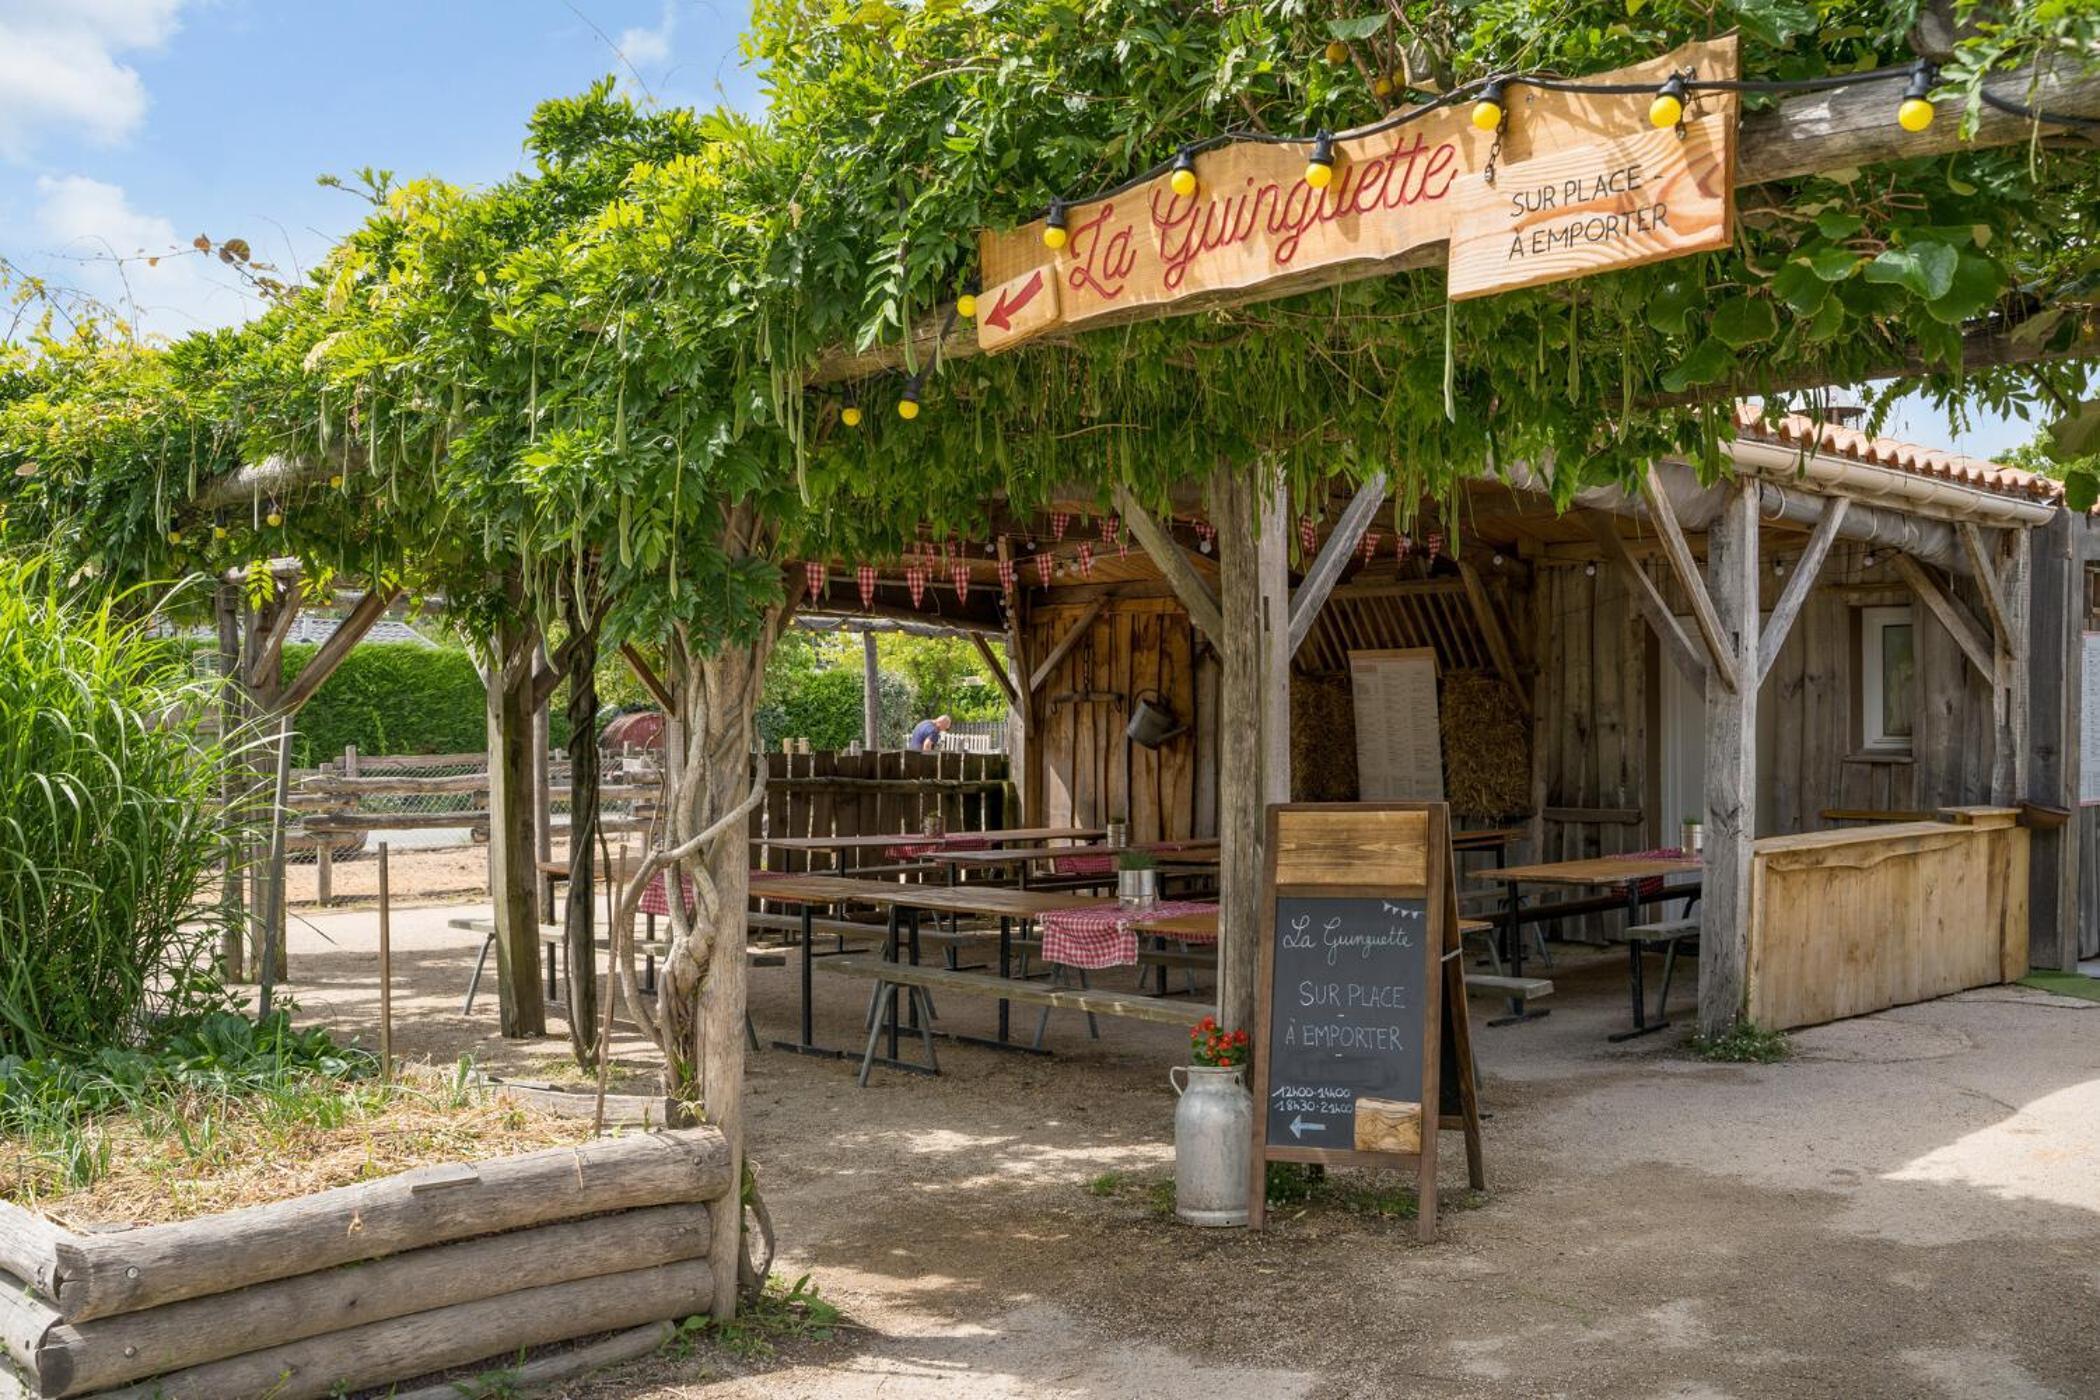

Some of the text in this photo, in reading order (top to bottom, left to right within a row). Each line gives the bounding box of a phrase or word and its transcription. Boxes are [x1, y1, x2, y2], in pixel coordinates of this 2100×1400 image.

[1069, 133, 1458, 299] La Guinguette
[1510, 185, 1556, 217] SUR
[1563, 164, 1642, 206] PLACE
[1532, 202, 1669, 254] EMPORTER
[1282, 914, 1414, 966] La Guinguette
[1299, 980, 1406, 1009] SUR PLACE
[1302, 1024, 1404, 1051] EMPORTER
